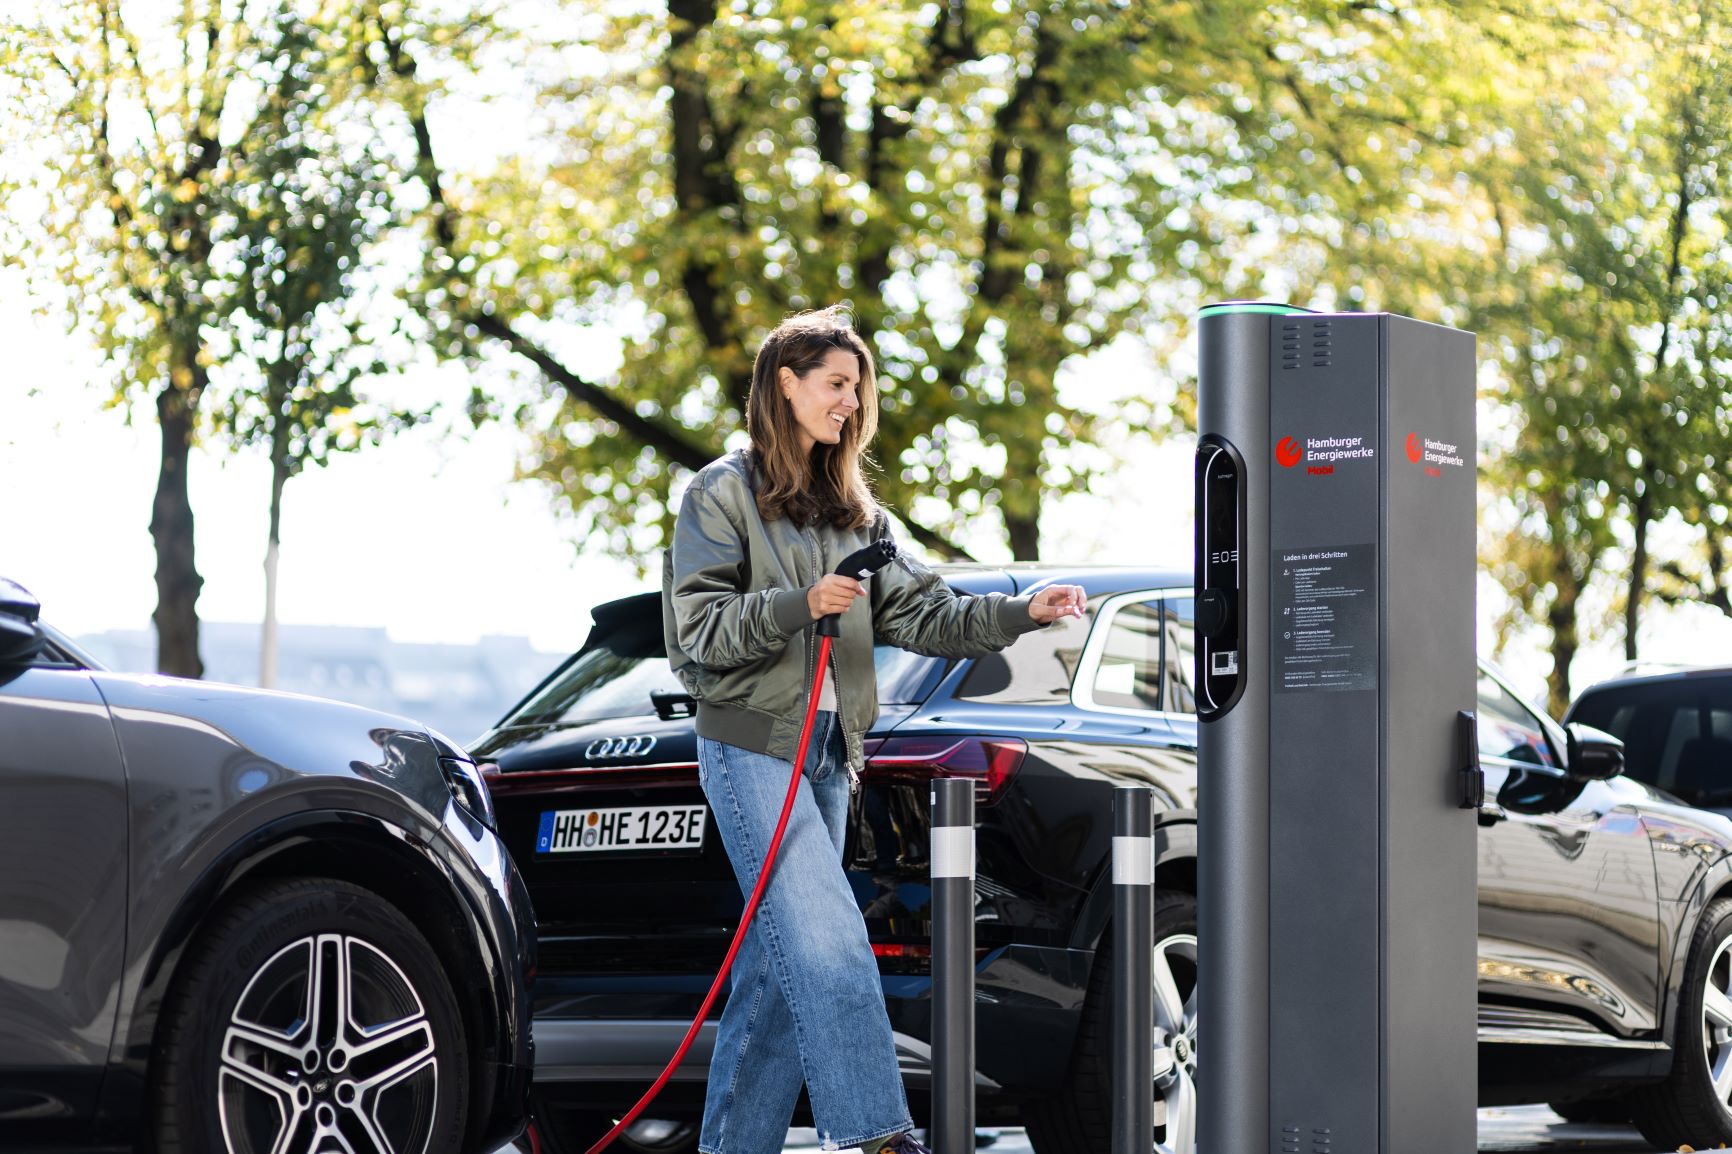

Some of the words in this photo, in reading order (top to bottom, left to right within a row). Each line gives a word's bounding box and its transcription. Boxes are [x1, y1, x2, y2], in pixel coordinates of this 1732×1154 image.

[1307, 437, 1362, 449] Hamburger
[1425, 438, 1457, 454] Hamburger
[1307, 447, 1374, 461] Energiewerke
[1425, 450, 1464, 467] Energiewerke
[1283, 553, 1301, 561] Laden
[1309, 552, 1320, 560] drei
[1321, 551, 1348, 559] Schritten
[552, 815, 585, 848] HH
[599, 812, 632, 845] HE
[635, 809, 704, 844] 123E
[541, 837, 548, 847] D
